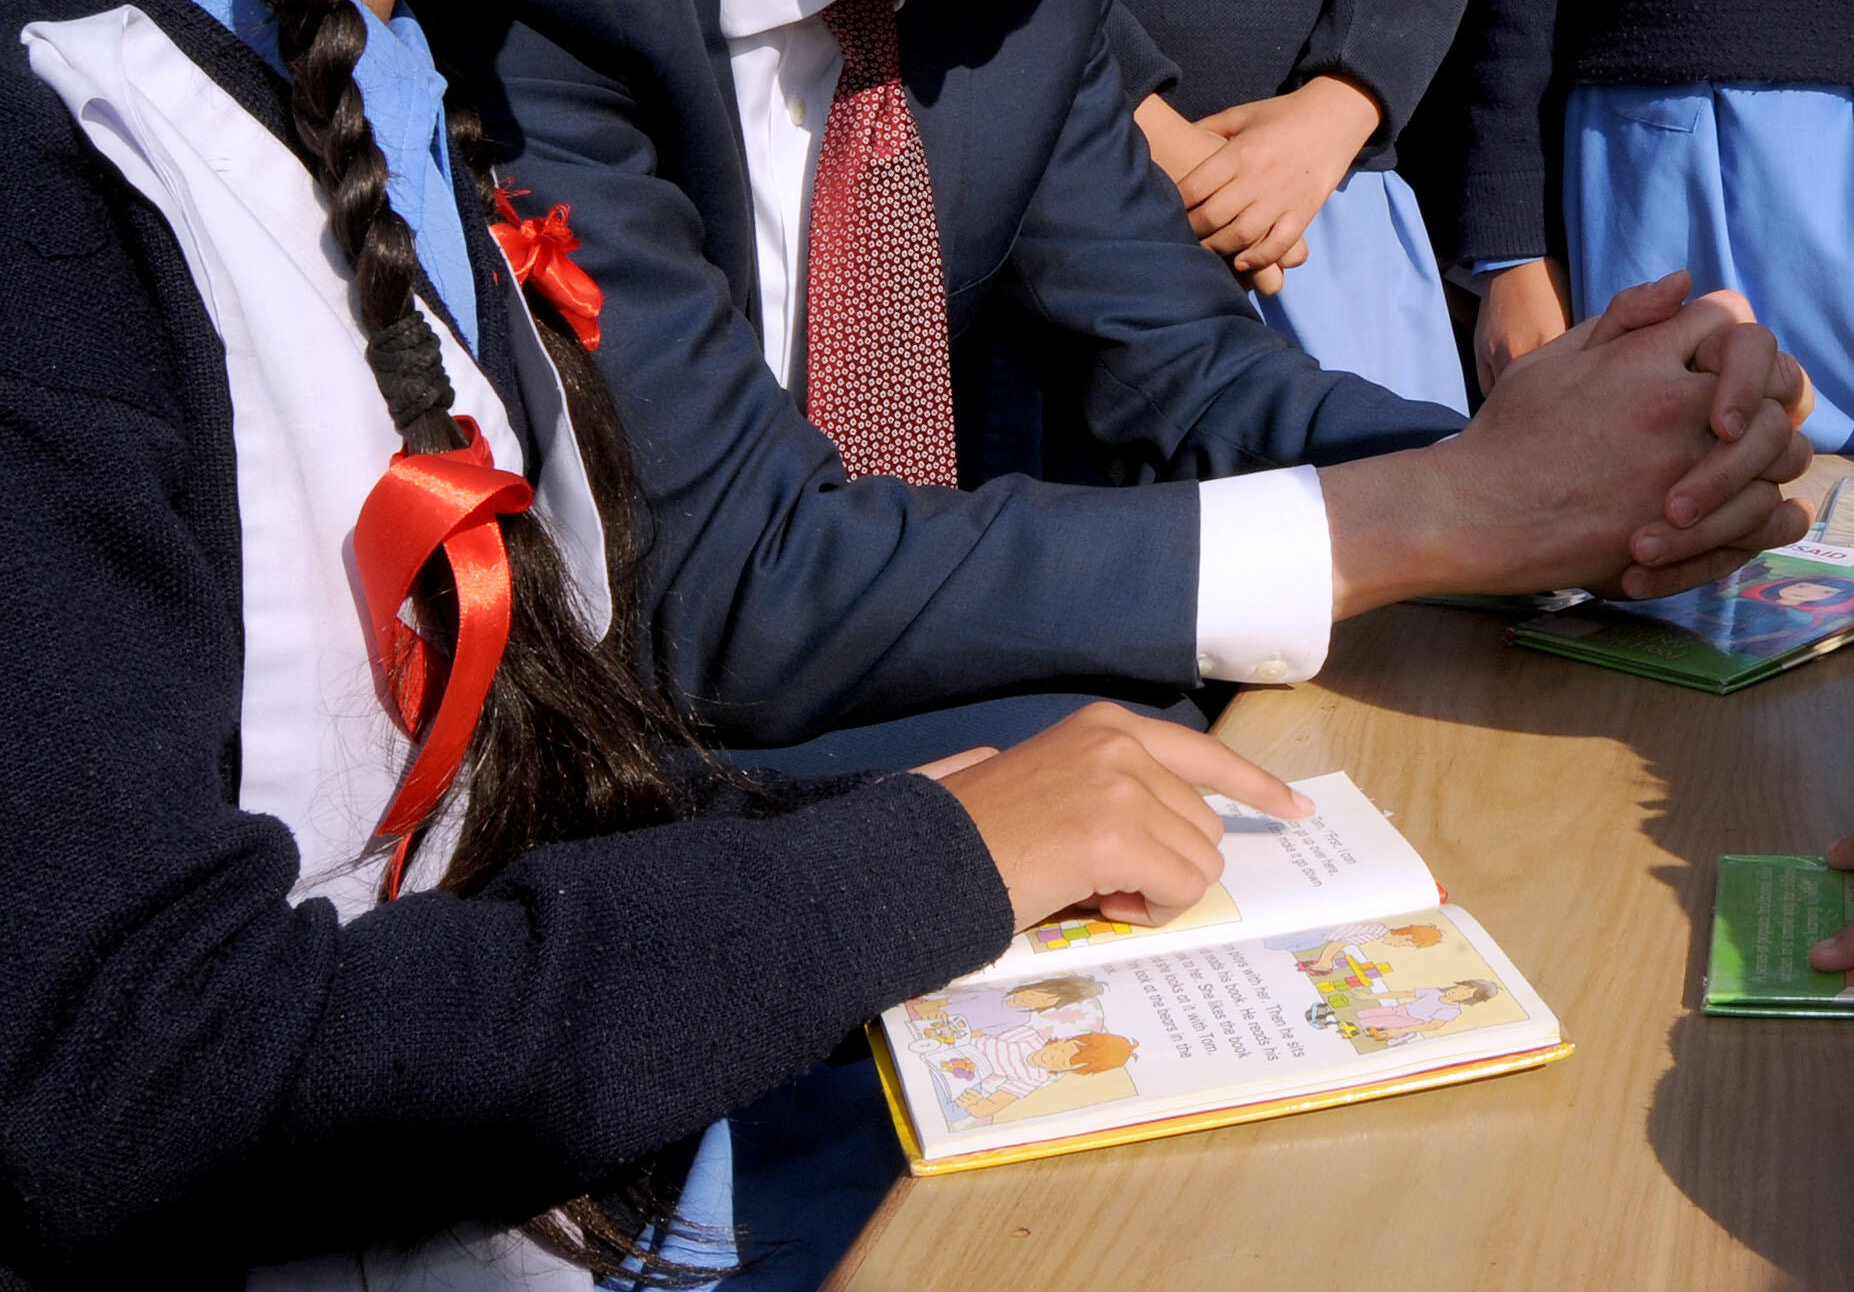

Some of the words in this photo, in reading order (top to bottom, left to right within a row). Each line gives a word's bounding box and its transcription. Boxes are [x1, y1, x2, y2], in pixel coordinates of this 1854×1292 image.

[1154, 962, 1171, 973] she
[1204, 954, 1224, 970] reads
[1134, 969, 1152, 983] look
[1164, 973, 1184, 993] looks
[1217, 970, 1233, 982] his
[1242, 968, 1263, 985] with
[1143, 984, 1157, 993] at
[1224, 982, 1247, 1006] book.
[1148, 993, 1164, 1007] the
[1176, 994, 1191, 1004] at
[1181, 960, 1195, 968] to
[1197, 982, 1214, 999] She
[1218, 1020, 1235, 1034] the
[1227, 1035, 1252, 1058] book
[1182, 1003, 1196, 1012] it
[1239, 1007, 1256, 1020] He
[1156, 1007, 1177, 1032] bears
[1186, 1013, 1208, 1032] with
[1265, 1005, 1286, 1026] Then
[1169, 1032, 1184, 1042] in
[1247, 1021, 1270, 1046] reads
[1279, 1028, 1294, 1039] he
[1175, 1043, 1192, 1058] the
[1198, 1033, 1217, 1056] Tom.
[1286, 1041, 1304, 1057] sits
[1262, 1046, 1280, 1061] his
